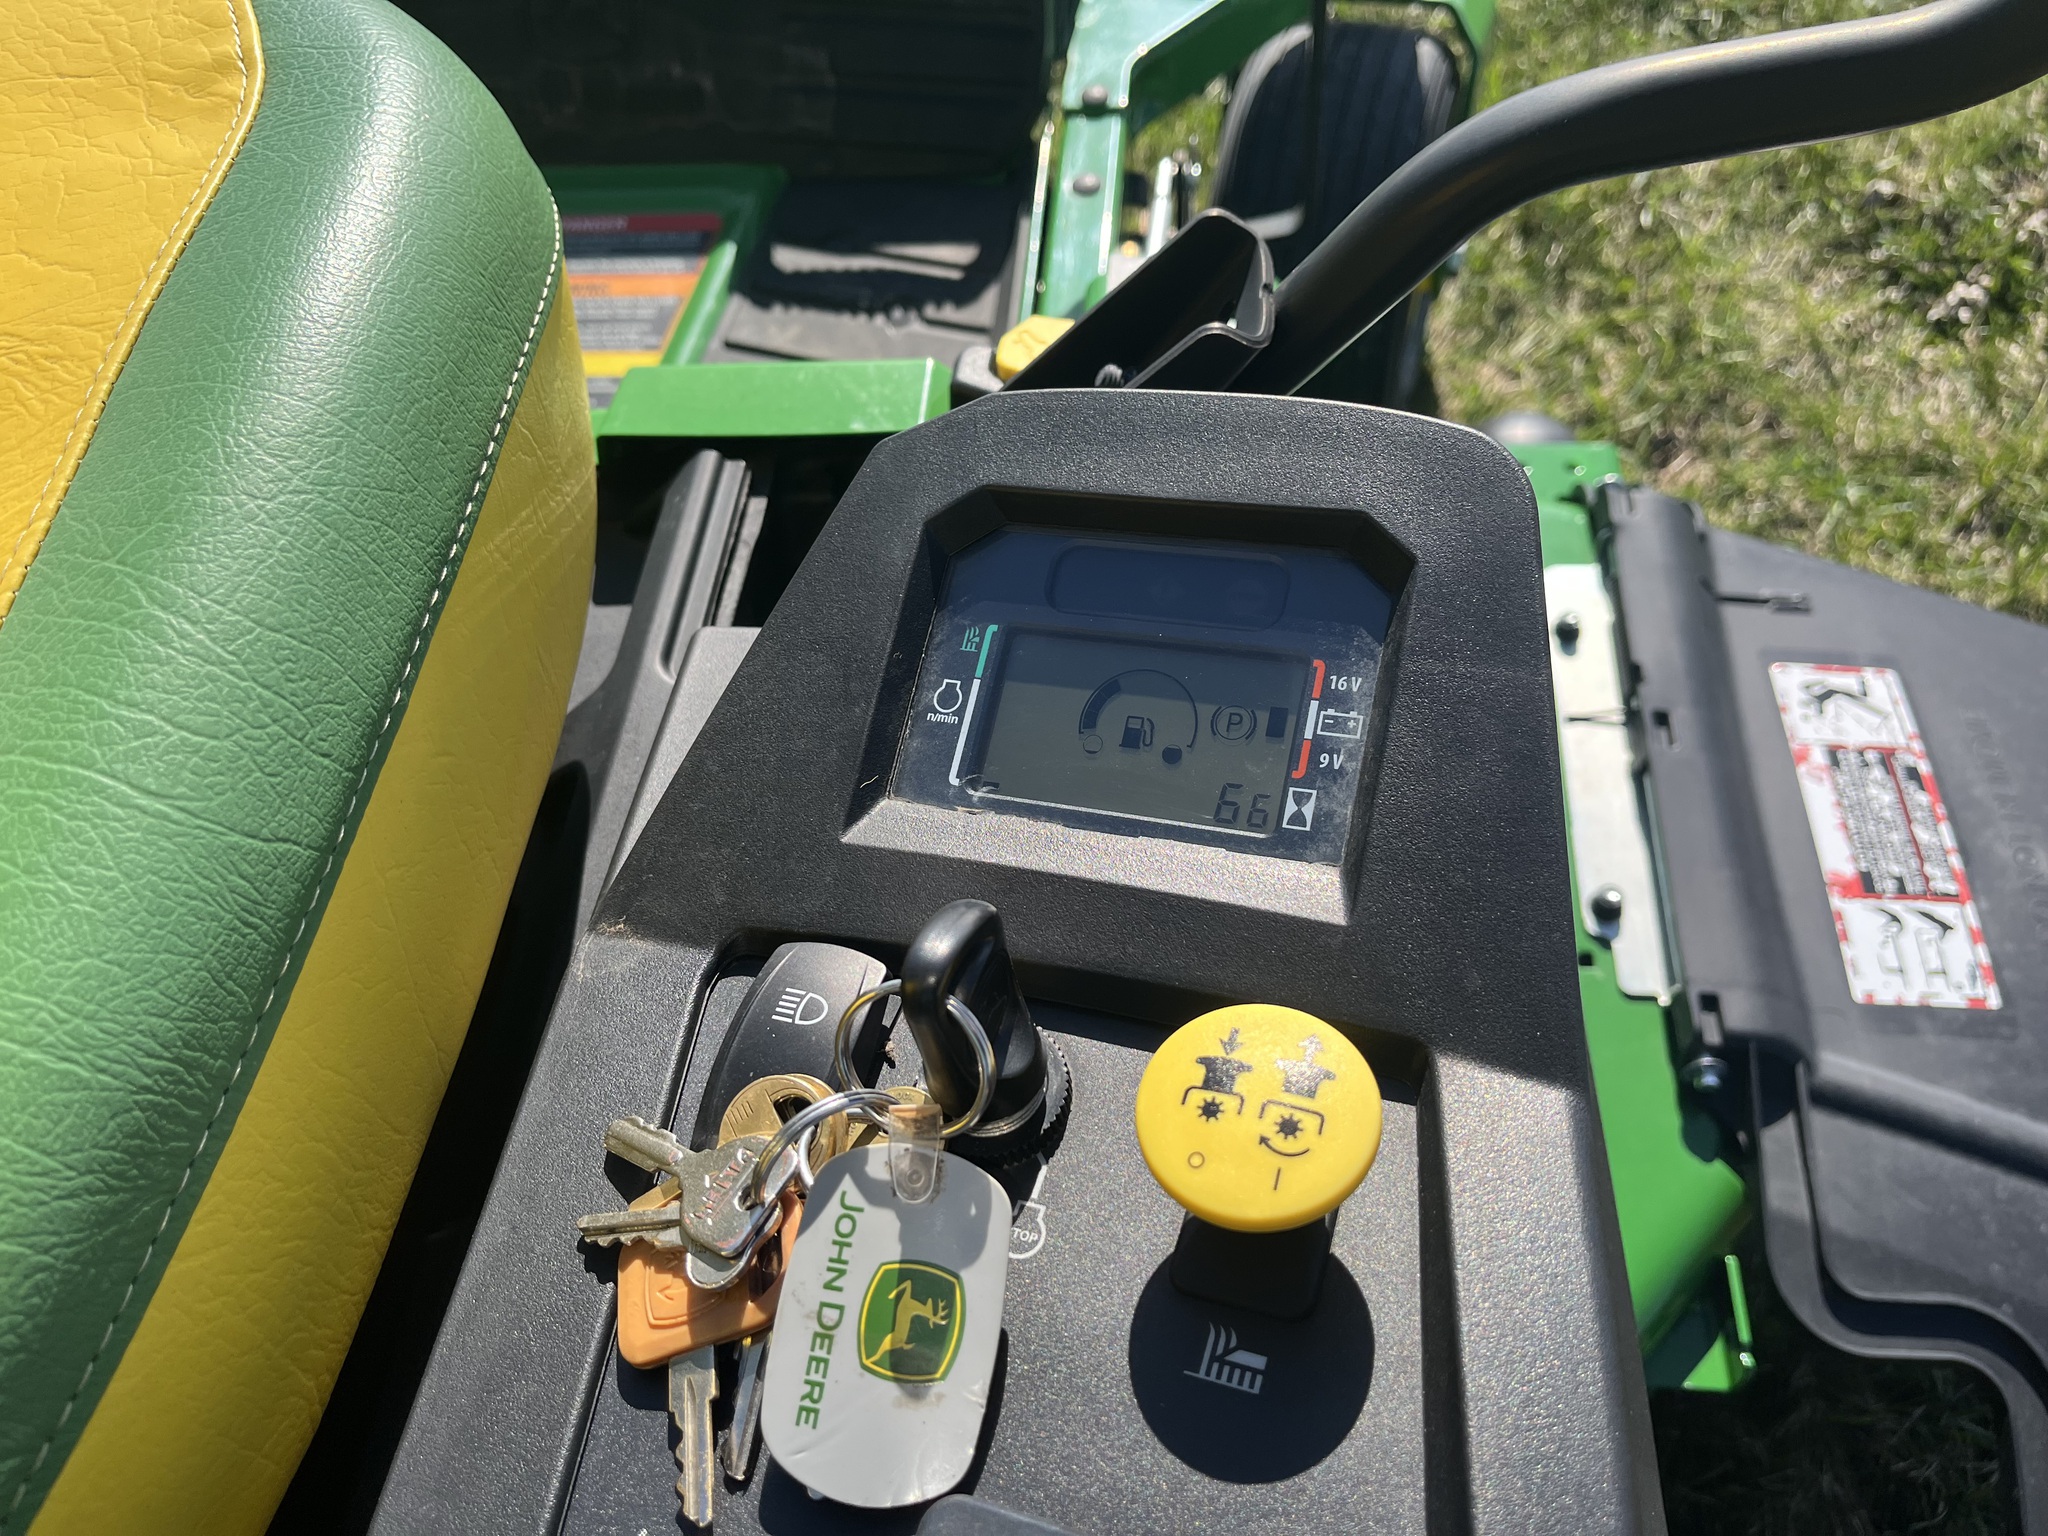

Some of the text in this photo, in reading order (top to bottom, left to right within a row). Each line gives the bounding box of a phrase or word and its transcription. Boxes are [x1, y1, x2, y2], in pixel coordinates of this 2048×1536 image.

[926, 712, 959, 724] n/min
[1010, 1227, 1039, 1243] TOP
[795, 1190, 865, 1430] JOHN DEERE
